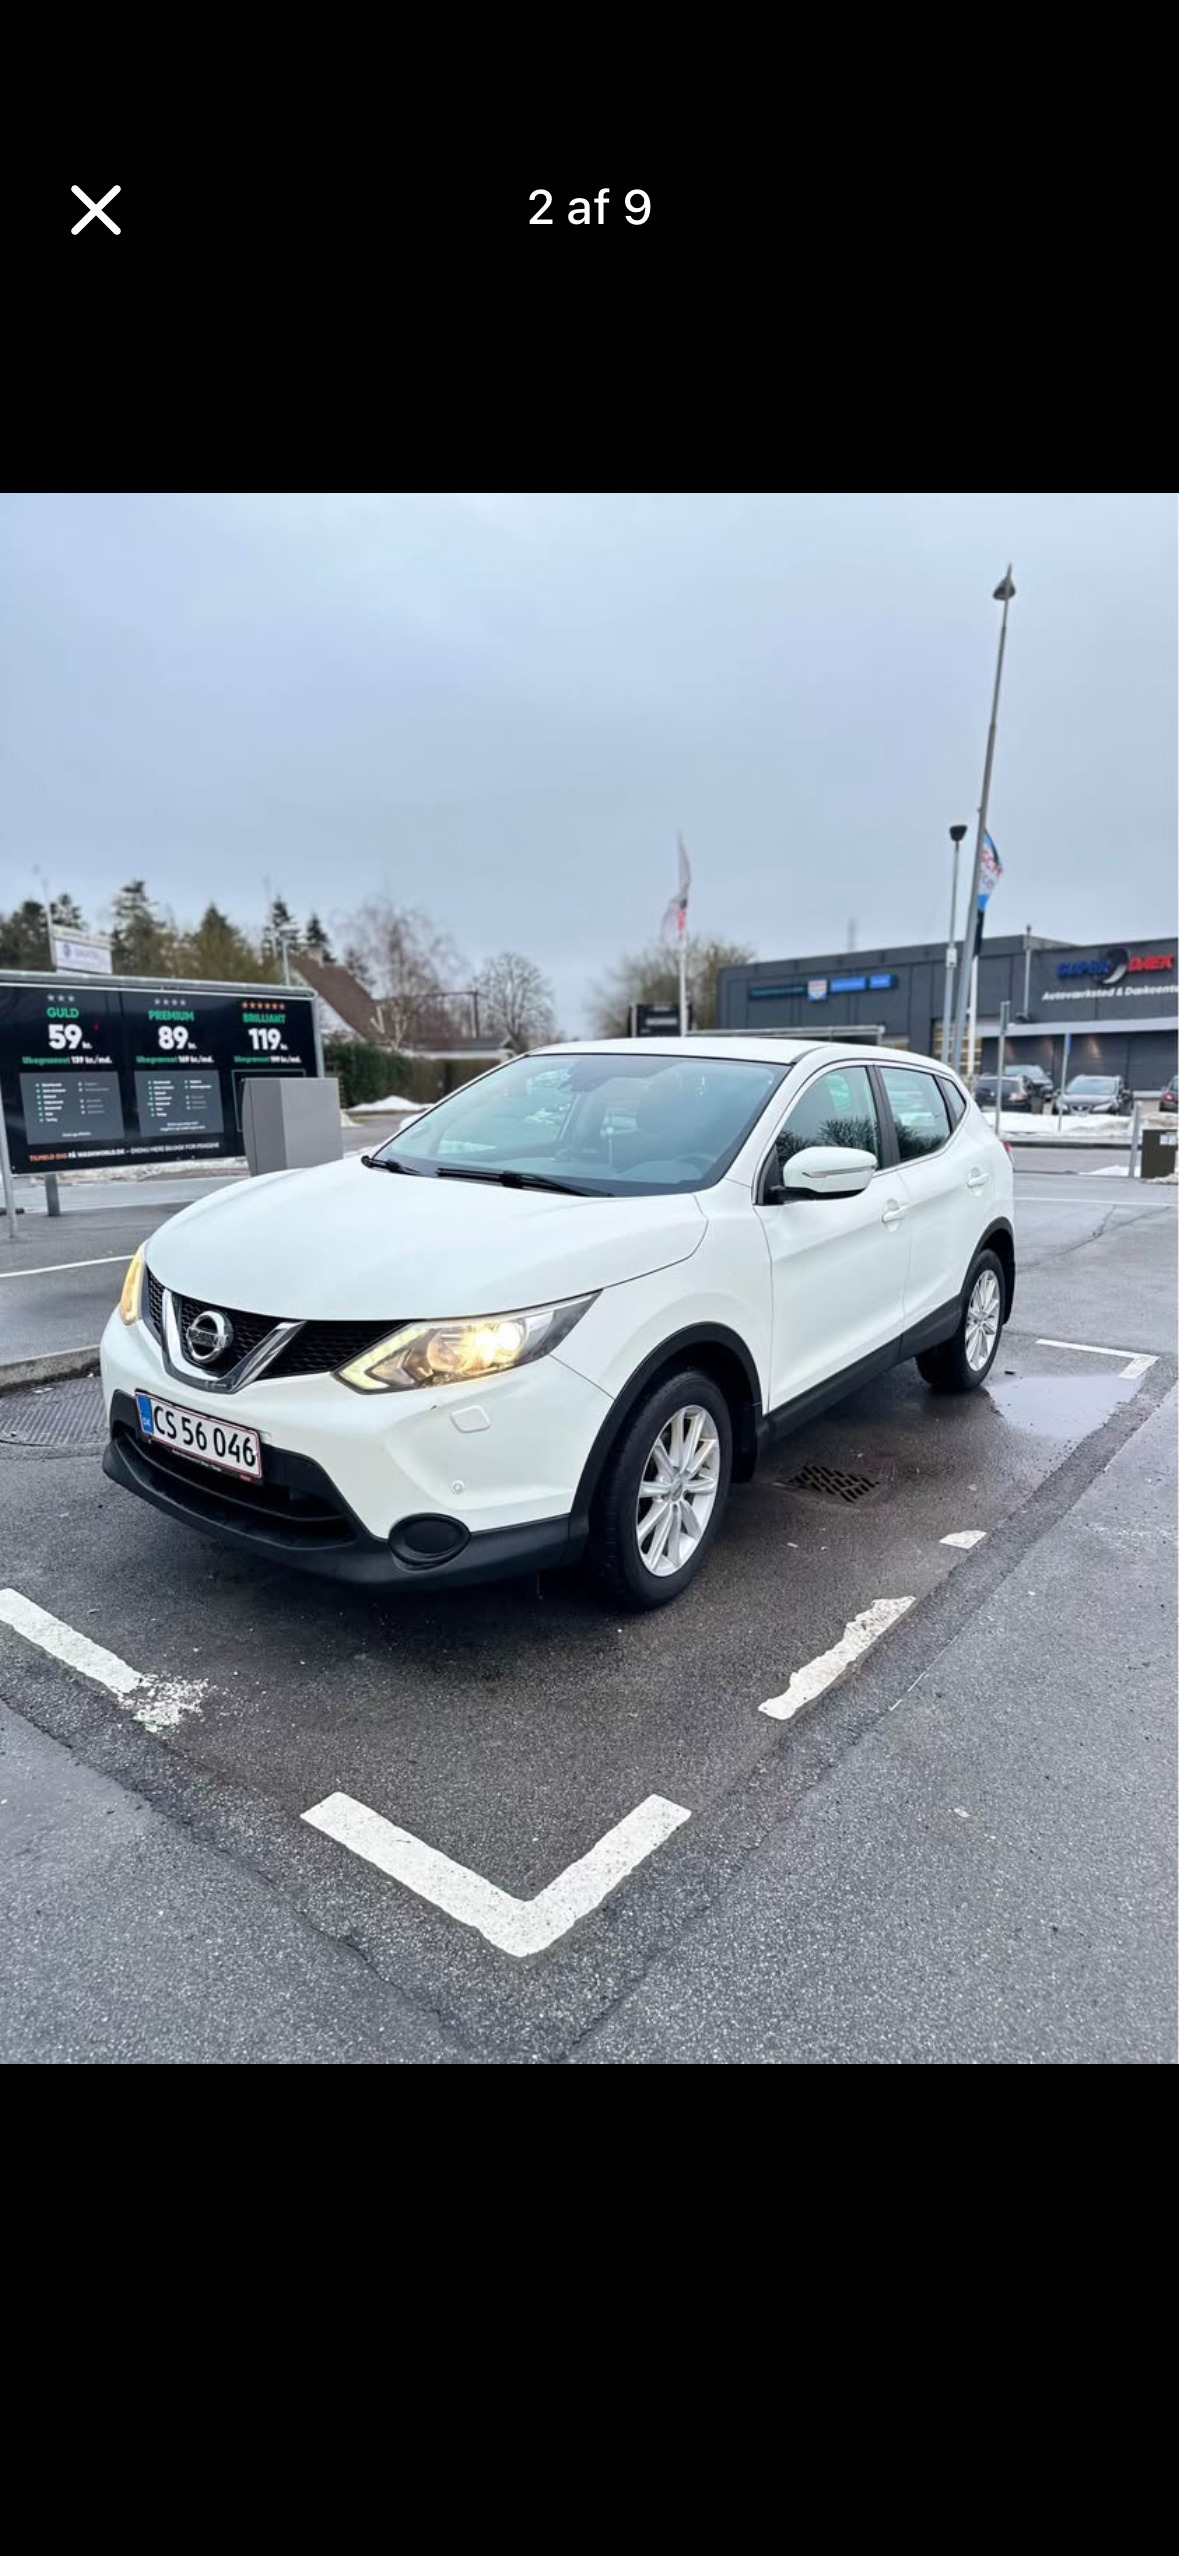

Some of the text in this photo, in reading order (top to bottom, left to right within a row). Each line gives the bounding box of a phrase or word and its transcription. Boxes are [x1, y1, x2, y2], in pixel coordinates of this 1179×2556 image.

[47, 1007, 79, 1018] GULD
[148, 1010, 195, 1022] PREMIUM
[243, 1013, 286, 1024] BRILLIANT
[48, 1023, 83, 1050] 59
[158, 1026, 188, 1050] 89
[248, 1027, 281, 1050] 119
[154, 1406, 177, 1439] CS
[182, 1417, 207, 1450] 56
[214, 1428, 256, 1466] 046
